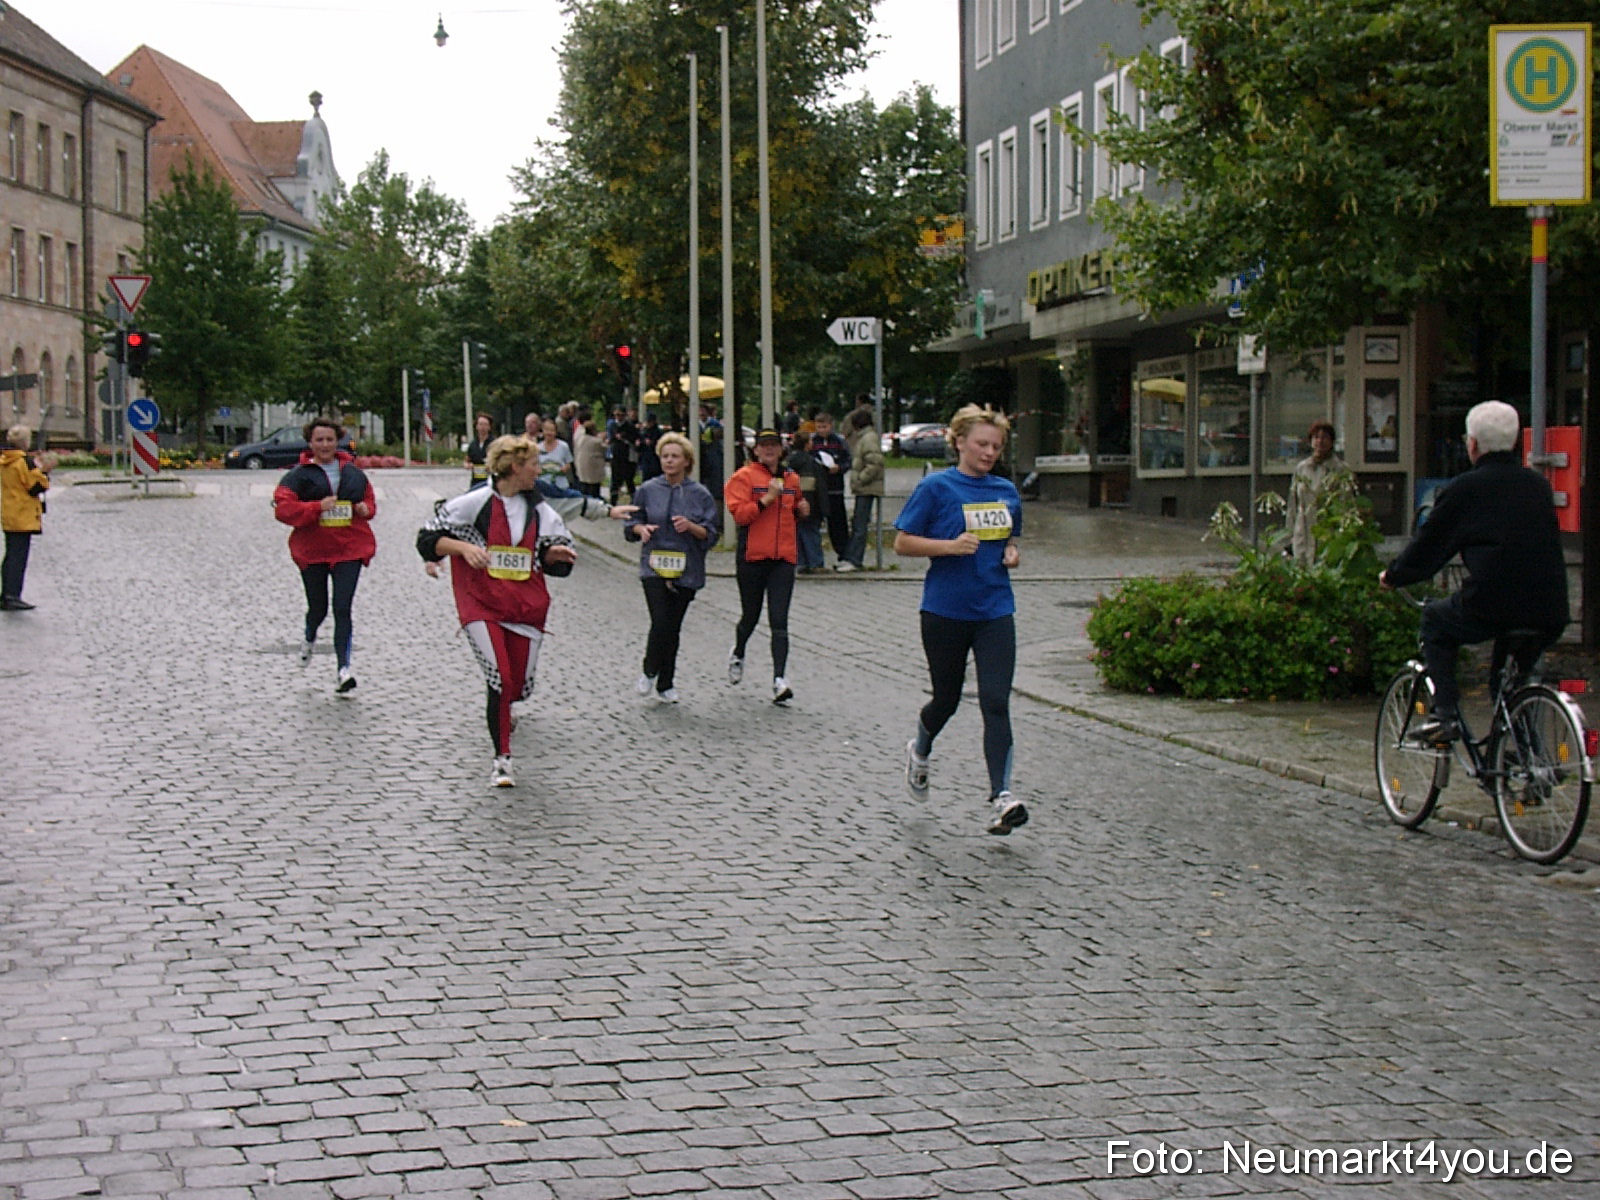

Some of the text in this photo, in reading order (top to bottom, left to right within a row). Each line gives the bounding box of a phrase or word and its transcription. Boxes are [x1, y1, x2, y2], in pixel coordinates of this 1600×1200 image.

[1525, 56, 1557, 94] H
[1503, 122, 1578, 132] Oberer Markt
[841, 321, 869, 341] WC
[974, 510, 1007, 526] 1420
[496, 553, 526, 568] 1681
[657, 556, 681, 568] 1611
